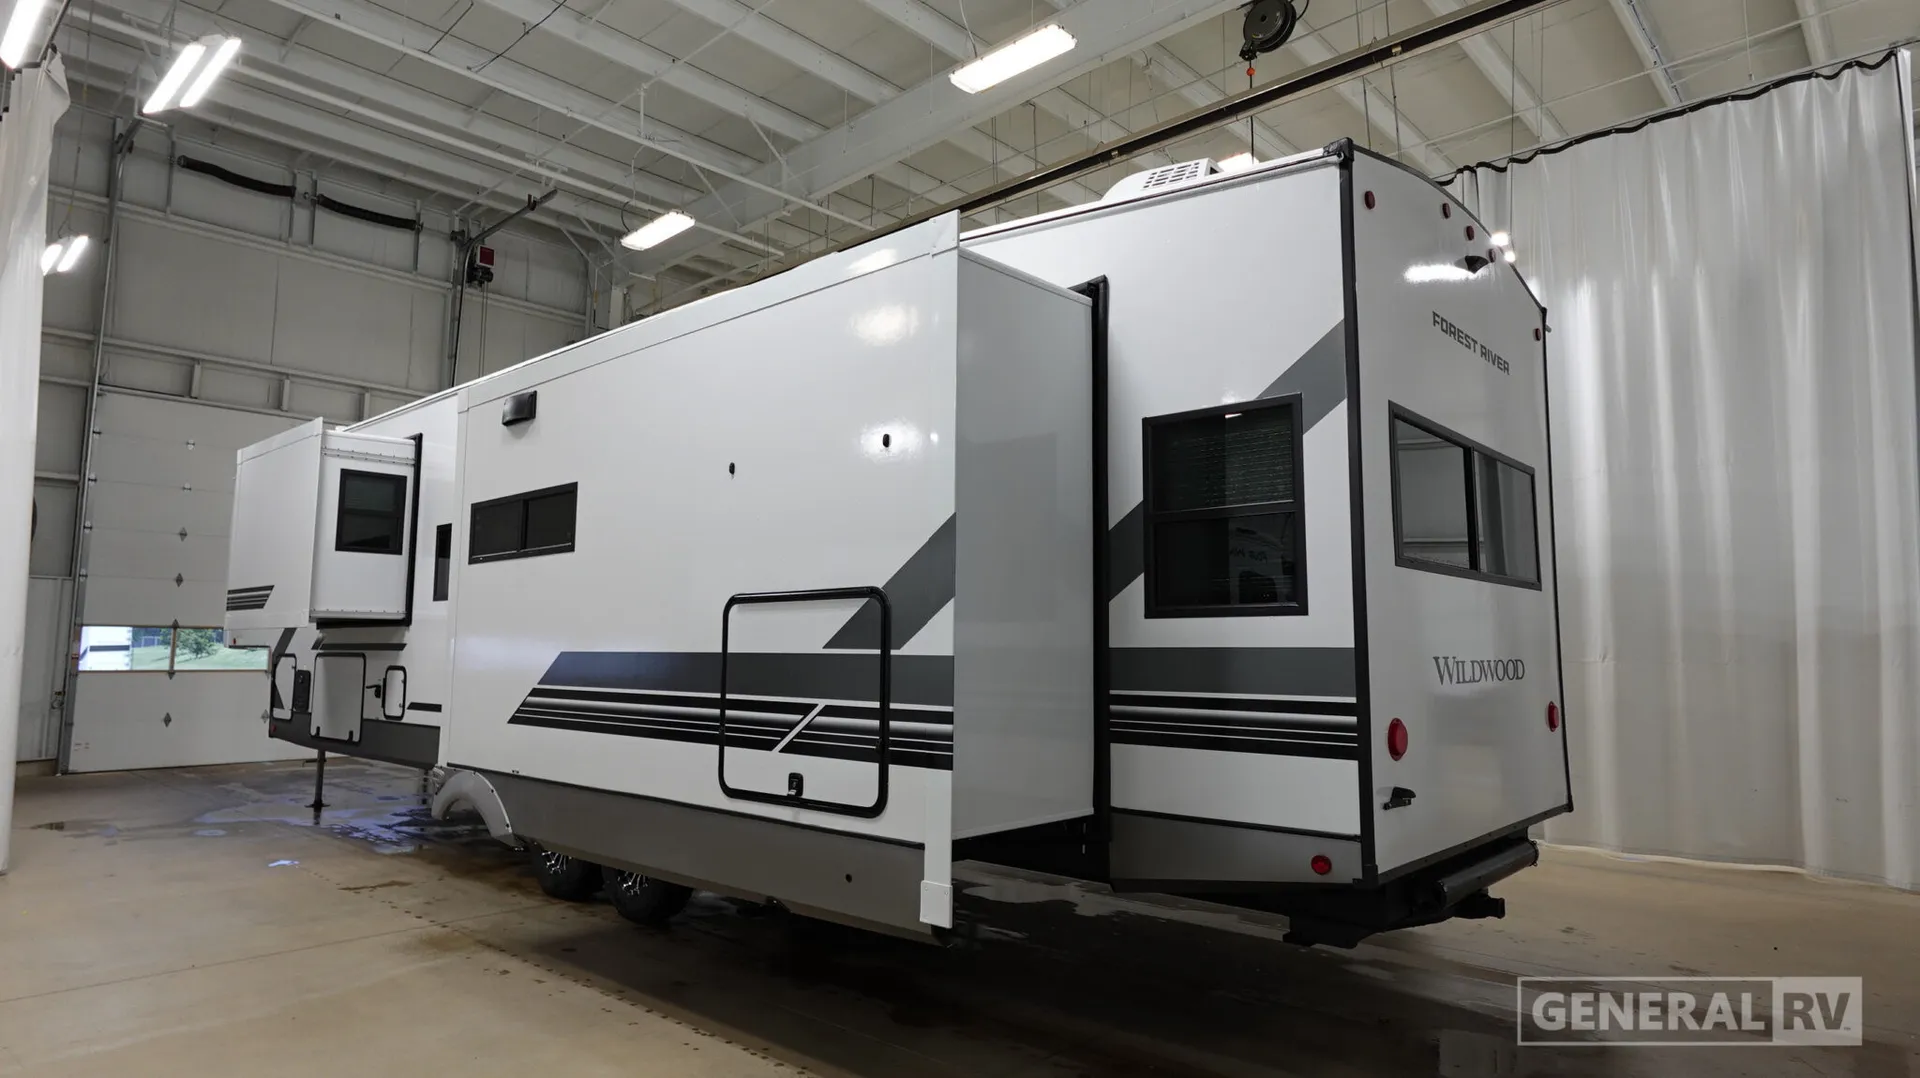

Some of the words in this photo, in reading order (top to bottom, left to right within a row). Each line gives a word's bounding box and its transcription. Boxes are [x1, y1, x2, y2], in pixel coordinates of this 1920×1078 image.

[1432, 310, 1478, 353] FOREST
[1479, 343, 1510, 375] RIVER
[1432, 656, 1525, 685] WILDWOOD
